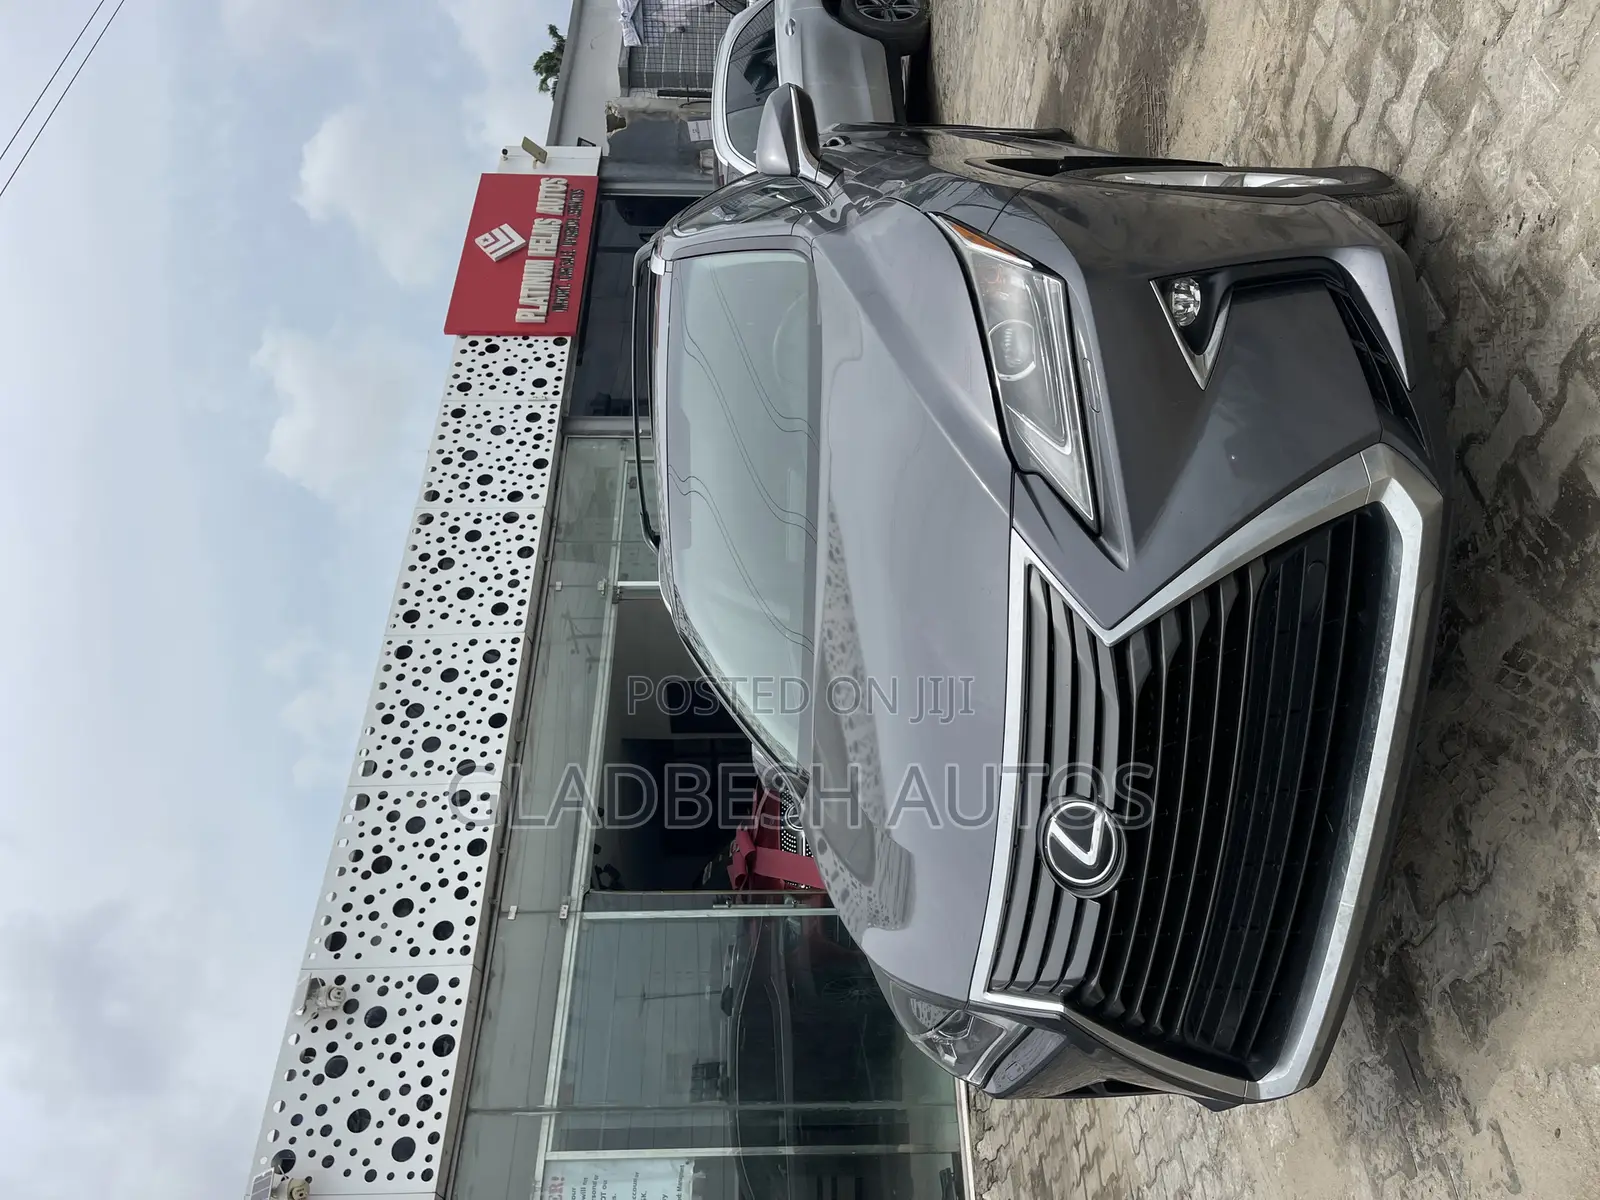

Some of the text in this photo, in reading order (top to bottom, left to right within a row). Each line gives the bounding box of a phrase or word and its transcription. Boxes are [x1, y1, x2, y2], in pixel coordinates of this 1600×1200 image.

[515, 177, 569, 323] PLATINUM HELMS AUTOS
